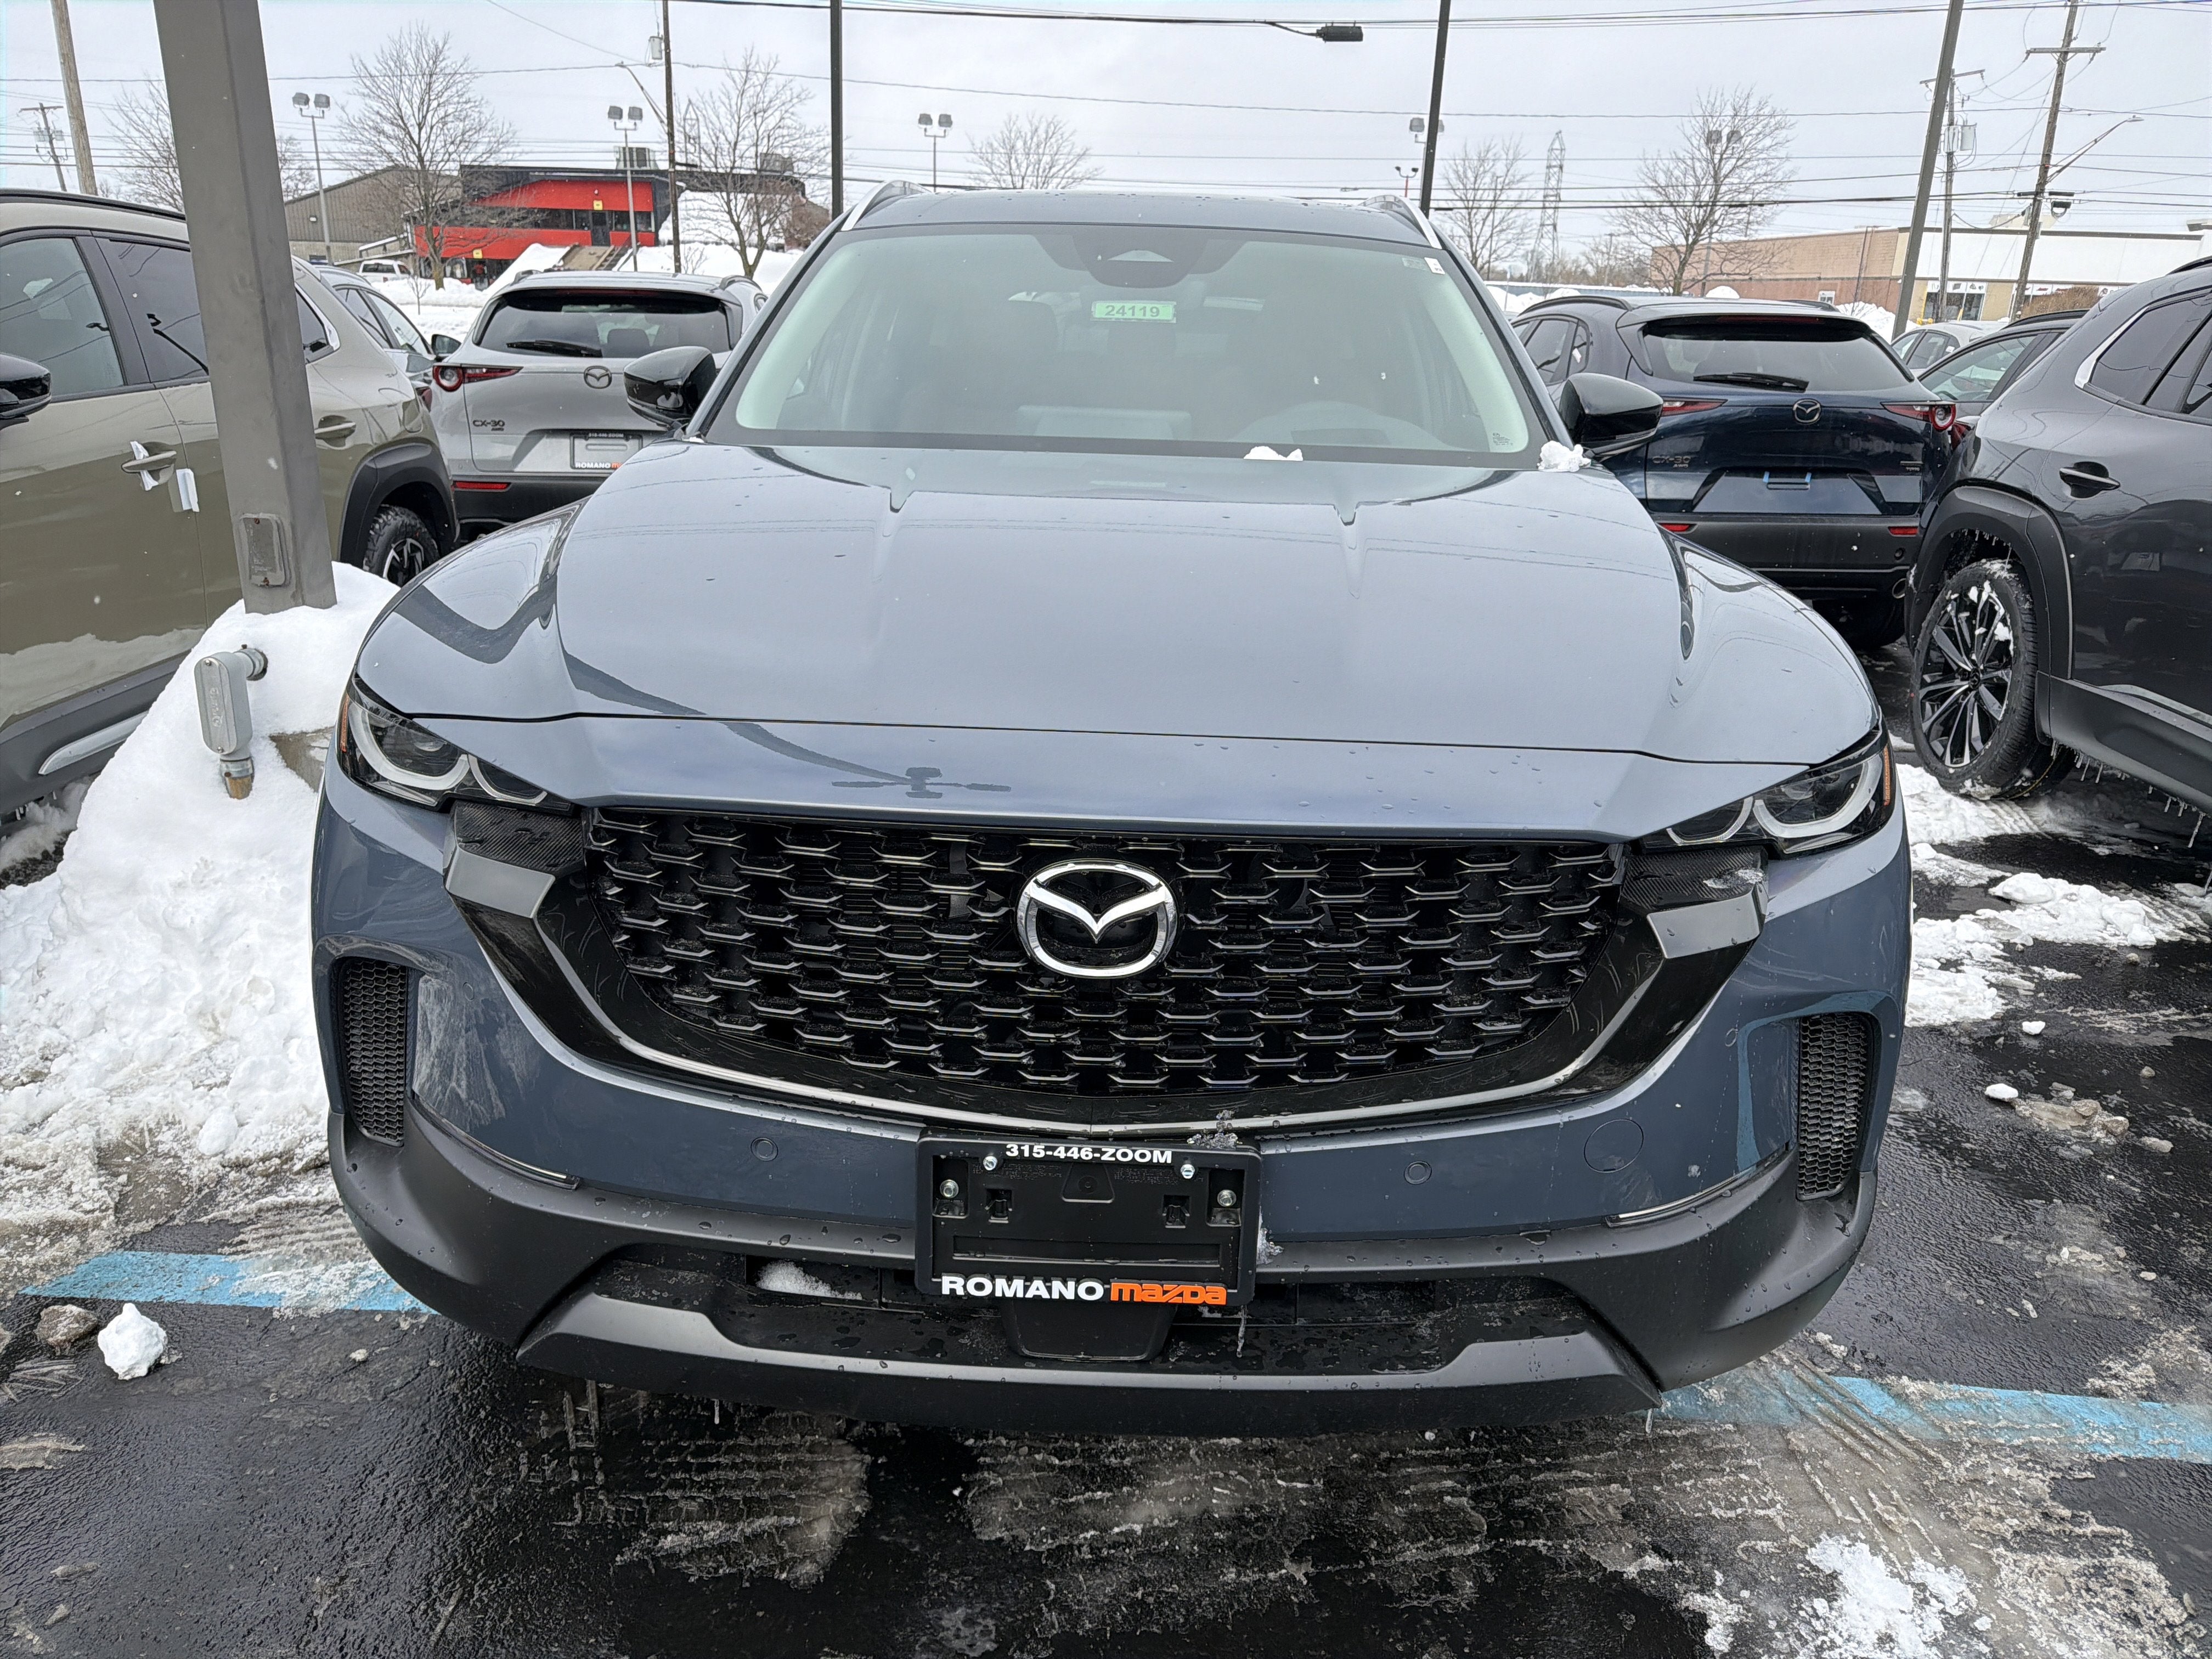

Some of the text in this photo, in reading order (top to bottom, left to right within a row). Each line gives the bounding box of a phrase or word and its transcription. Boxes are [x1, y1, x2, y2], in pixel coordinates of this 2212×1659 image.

[1105, 305, 1160, 317] 24119
[1006, 1144, 1172, 1163] 315-446-ZOOM
[941, 1276, 1227, 1305] ROMANO mazda
